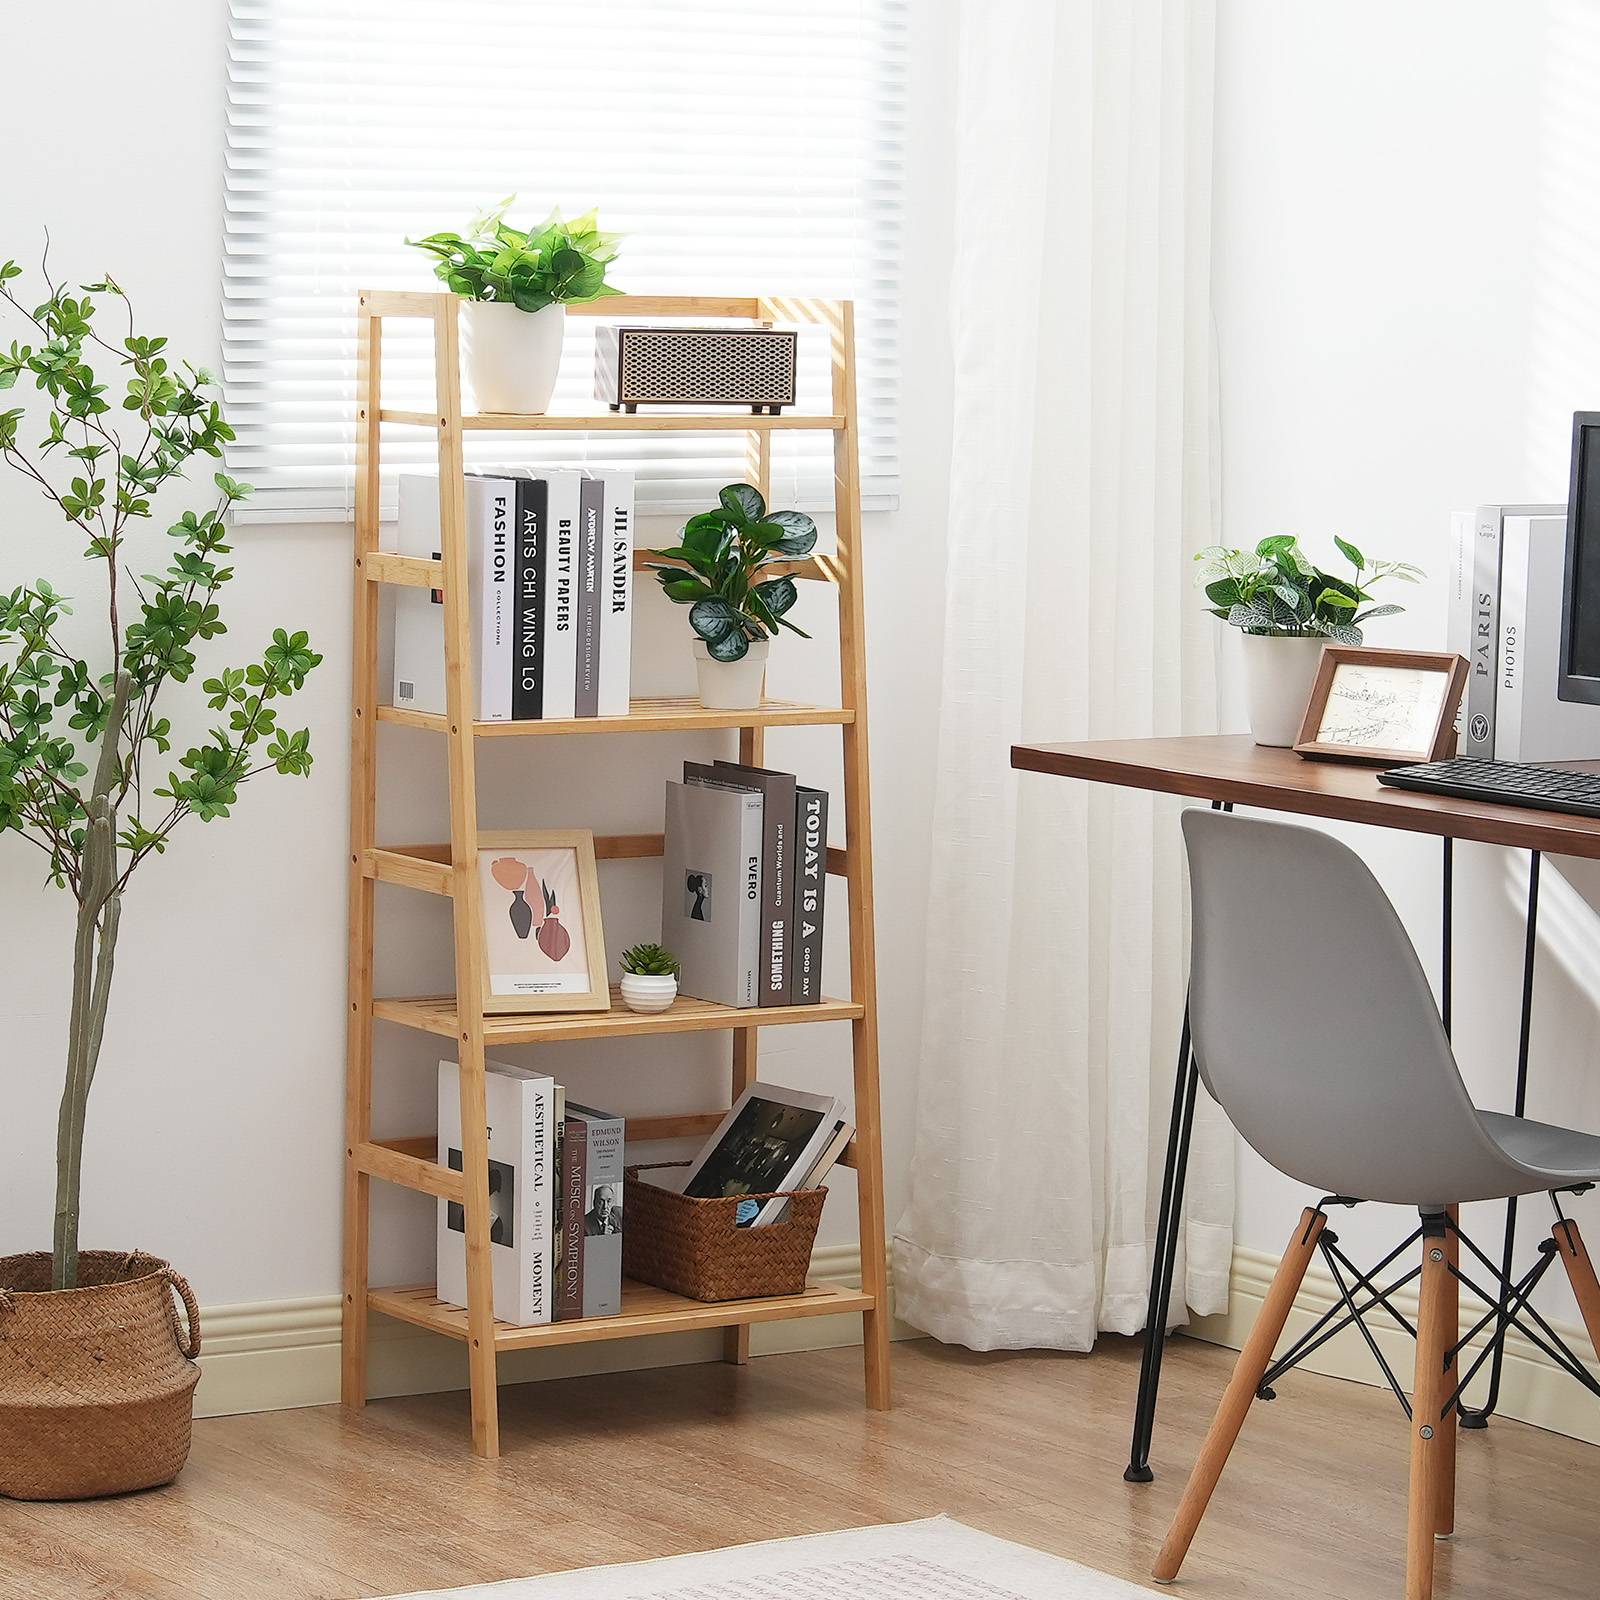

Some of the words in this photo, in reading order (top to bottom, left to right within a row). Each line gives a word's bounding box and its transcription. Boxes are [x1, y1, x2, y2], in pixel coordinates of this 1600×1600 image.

[494, 497, 506, 582] FASHION
[523, 509, 537, 558] ARTS
[558, 520, 571, 573] BEAUTY
[587, 507, 597, 552] ANDREW
[523, 567, 536, 599] CHI
[586, 553, 597, 593] MARTIN
[557, 579, 569, 632] PAPERS
[522, 608, 536, 658] WING
[1476, 593, 1491, 677] PARIS
[1504, 626, 1516, 689] PHOTOS
[522, 667, 535, 691] LO
[776, 824, 784, 841] and
[805, 799, 820, 879] TODAY
[748, 856, 757, 900] EVERO
[803, 889, 817, 912] IS
[802, 921, 816, 938] A
[771, 920, 784, 991] SOMETHING
[534, 1093, 544, 1191] AESTHETICAL
[592, 1127, 621, 1137] EDMUND
[592, 1139, 620, 1147] WILSON
[570, 1166, 582, 1208] MUSIC
[532, 1252, 543, 1316] MOMENT
[567, 1223, 580, 1300] SYMPHONY
